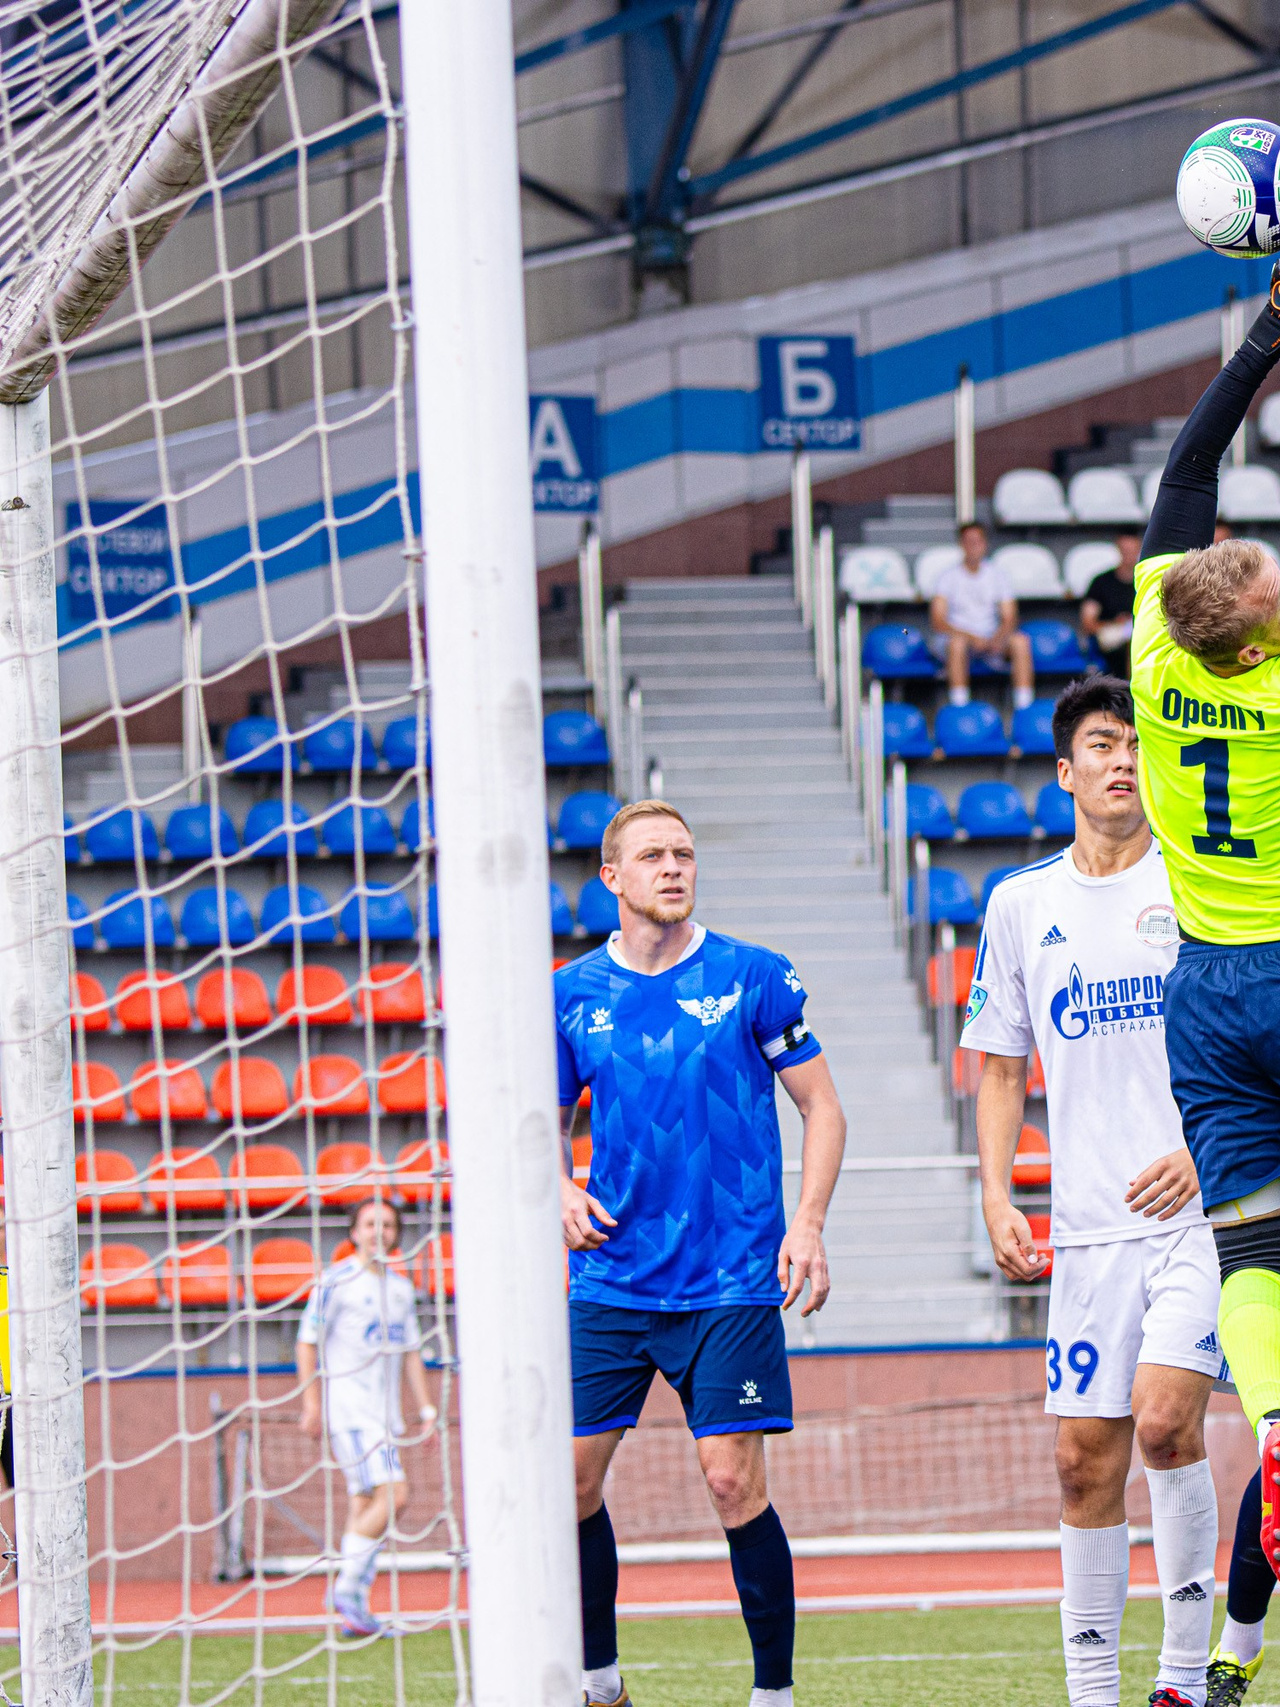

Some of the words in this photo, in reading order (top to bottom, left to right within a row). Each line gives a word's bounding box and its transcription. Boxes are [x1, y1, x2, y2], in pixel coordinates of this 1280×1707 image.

[778, 340, 837, 417] Б
[532, 480, 595, 507] КТОР
[1180, 737, 1258, 859] 1
[1040, 936, 1066, 947] adidas
[1091, 1003, 1159, 1024] ДОБЫЧ
[587, 1023, 614, 1034] KELME
[1046, 1337, 1099, 1396] 39
[739, 1396, 762, 1405] KELME
[1169, 1591, 1207, 1602] adidas
[1069, 1636, 1106, 1645] adidas
